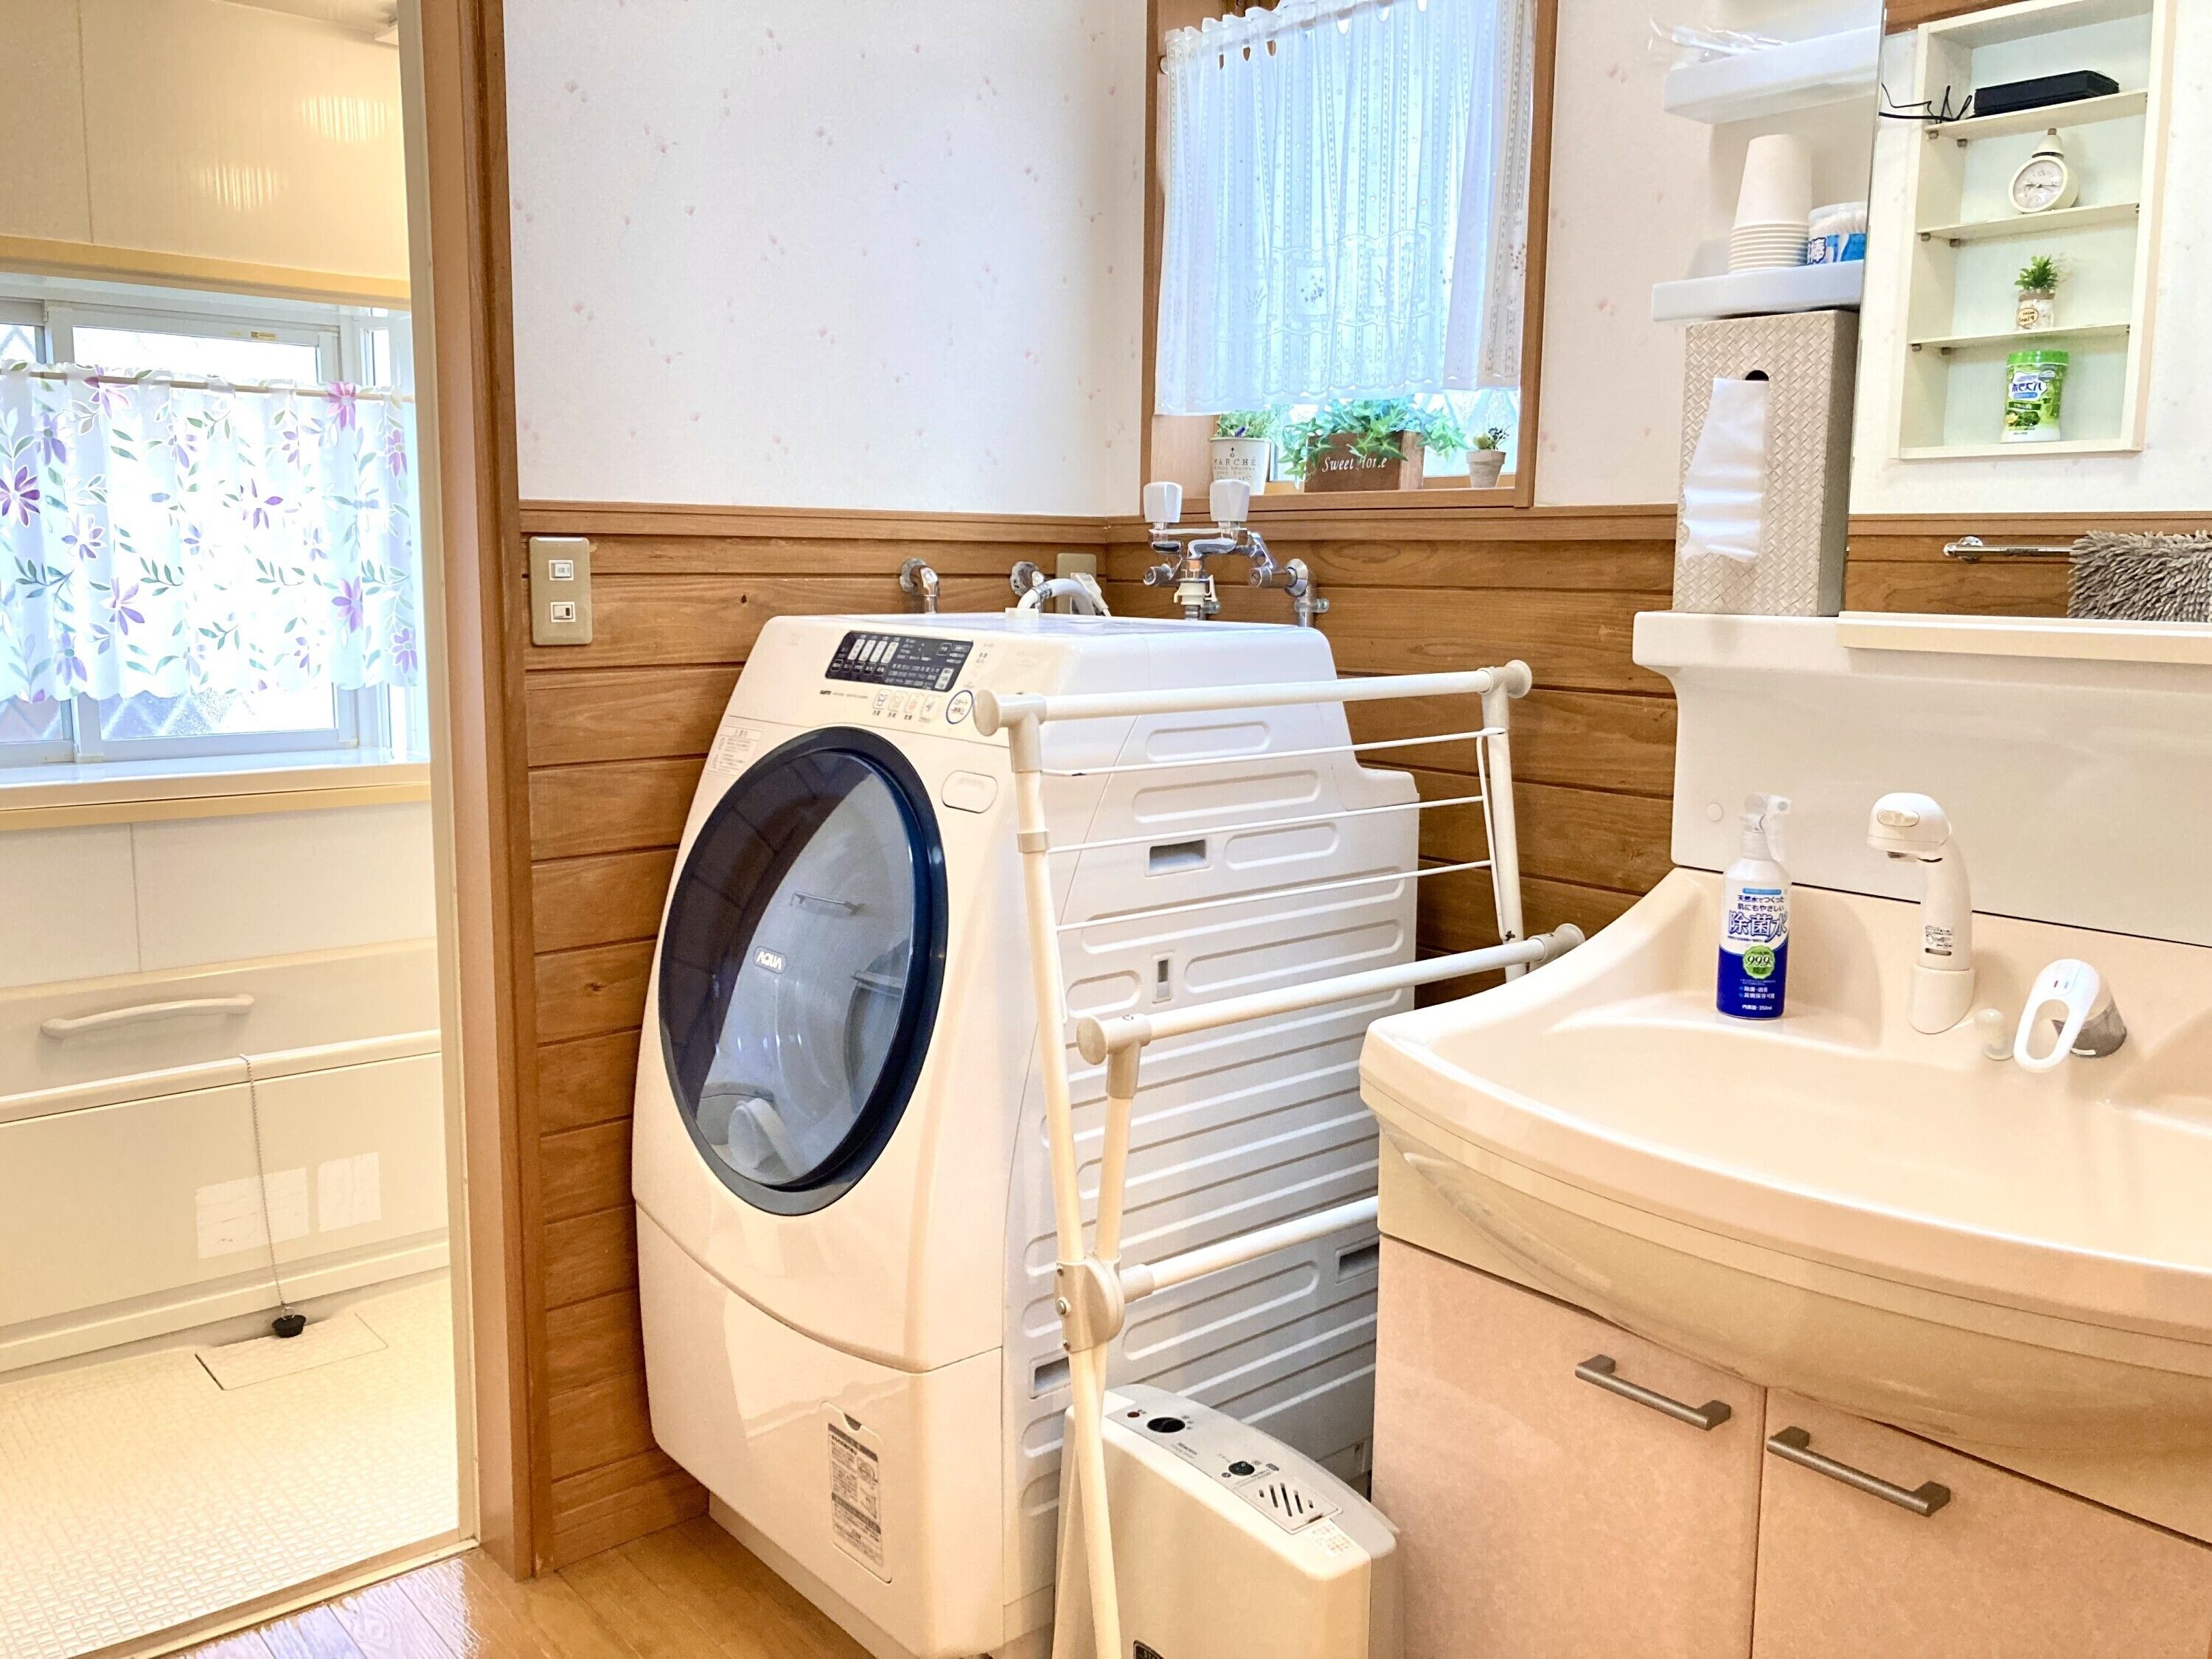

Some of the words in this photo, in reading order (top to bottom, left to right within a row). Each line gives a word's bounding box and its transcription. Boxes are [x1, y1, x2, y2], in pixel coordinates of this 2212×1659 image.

[1322, 456, 1354, 472] Sweet
[1737, 894, 1784, 903] 天然水でつくった
[1737, 903, 1784, 911] 肌にもやさしい
[1728, 910, 1787, 943] 除菌水
[756, 950, 782, 970] AQUA
